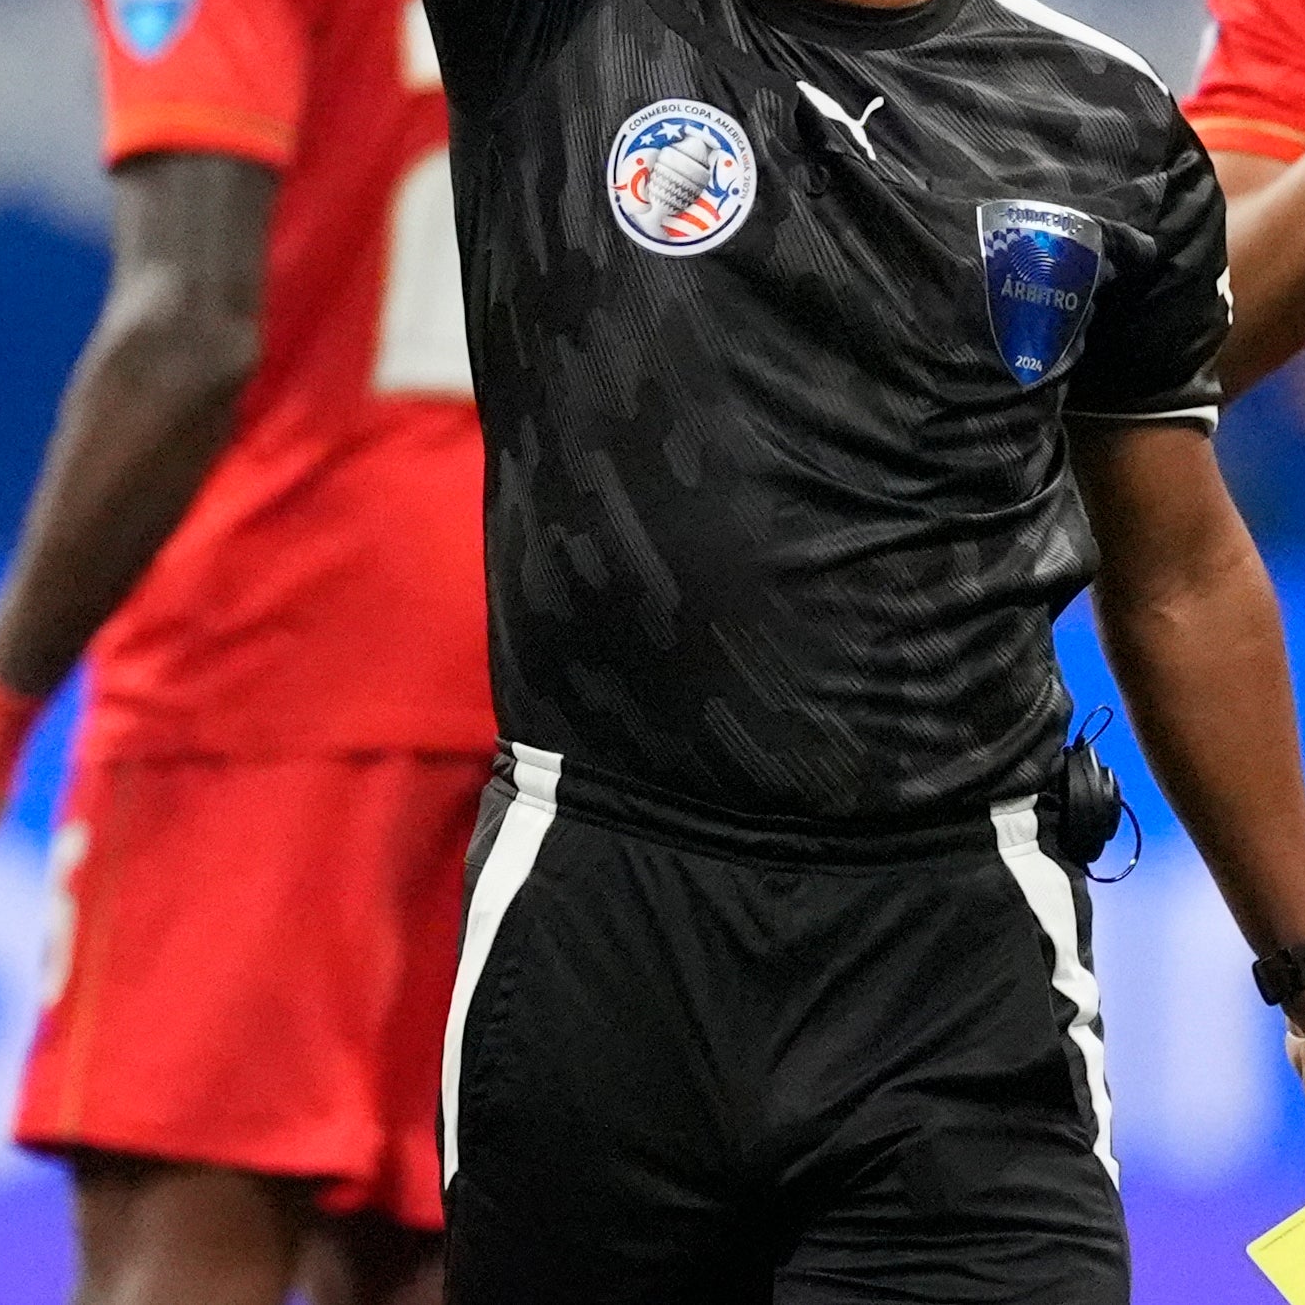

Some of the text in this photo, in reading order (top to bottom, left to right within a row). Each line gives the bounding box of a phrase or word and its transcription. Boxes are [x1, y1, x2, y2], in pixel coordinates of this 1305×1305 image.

[629, 103, 683, 132] CONMEBOL
[684, 105, 712, 120] COPA
[1014, 354, 1043, 373] 2024
